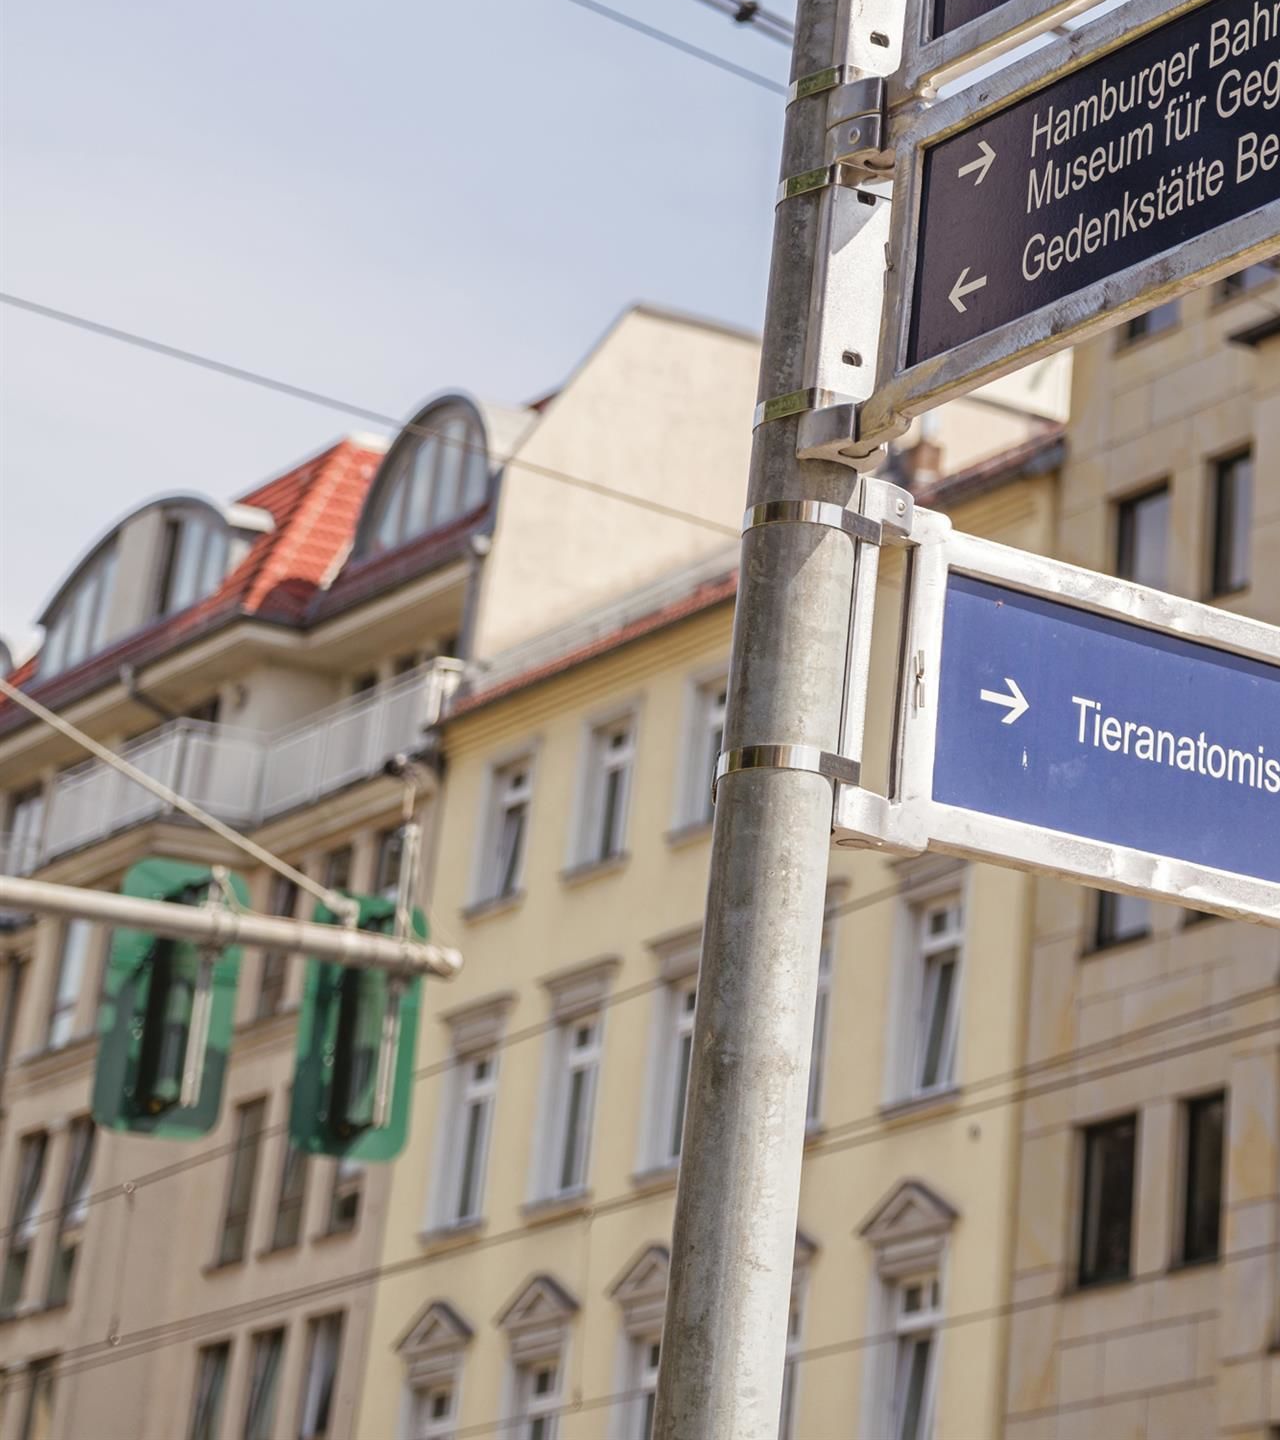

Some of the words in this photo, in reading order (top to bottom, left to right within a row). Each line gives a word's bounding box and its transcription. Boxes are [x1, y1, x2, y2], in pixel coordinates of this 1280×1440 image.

[1026, 122, 1154, 214] Museum
[1164, 93, 1207, 147] für
[1030, 42, 1200, 158] Hamburger
[1022, 156, 1224, 281] Gedenkstätte
